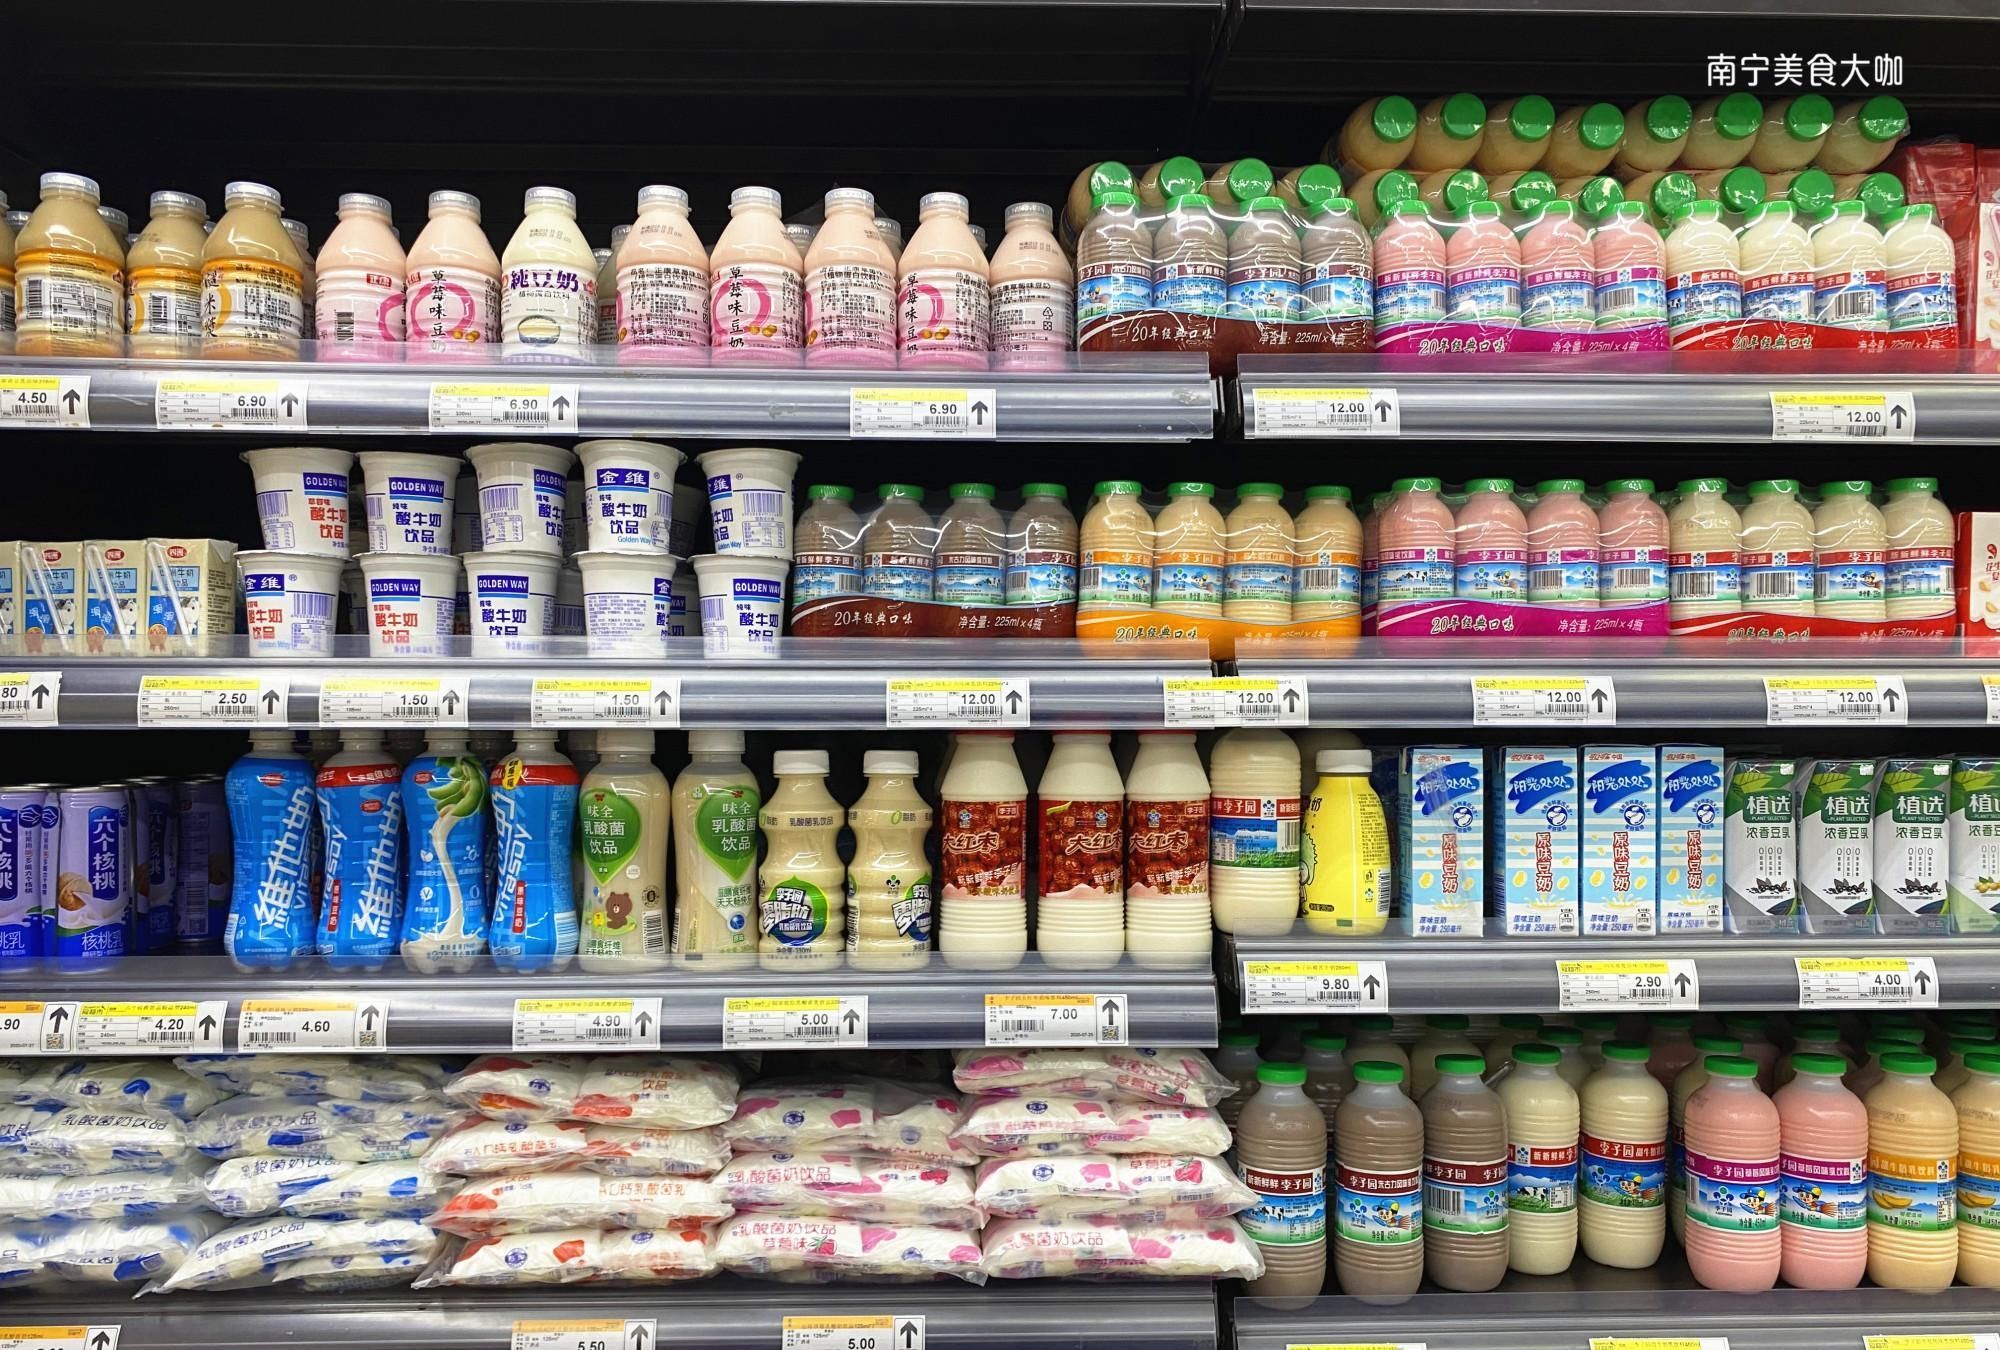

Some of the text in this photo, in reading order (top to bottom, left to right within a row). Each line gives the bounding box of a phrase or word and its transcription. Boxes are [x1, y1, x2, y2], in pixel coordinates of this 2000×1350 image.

[728, 266, 745, 348] 草莓味豆奶
[904, 273, 920, 355] 草莓味豆奶
[1130, 325, 1214, 342] 20年经典口味
[1418, 338, 1506, 357] 20年经典口味
[18, 392, 48, 404] 4.50
[237, 395, 267, 408] 6.90
[508, 398, 539, 411] 6.90
[928, 402, 958, 415] 6.90
[1329, 402, 1365, 413] 12.00
[1847, 411, 1882, 423] 12.00
[305, 476, 338, 487] GOLDEN
[599, 470, 647, 486] 金维
[391, 481, 444, 495] GOLDEN WAY
[310, 506, 347, 522] 酸牛奶
[601, 502, 647, 519] 酸牛奶
[395, 511, 442, 528] 酸牛奶
[319, 524, 344, 539] 饮品
[609, 520, 639, 535] 饮品
[404, 528, 435, 544] 饮品
[617, 535, 651, 546] Golden Way
[1477, 550, 1516, 561] 李子园
[1848, 550, 1883, 564] 李子园
[371, 582, 419, 592] GOLDEN WAY
[478, 579, 527, 590] GOLDEN WAY
[657, 581, 670, 594] 金
[735, 582, 762, 593] GOLDEN
[374, 612, 418, 627] 酸牛奶
[481, 608, 527, 623] 酸牛奶
[739, 612, 779, 628] 酸牛奶
[834, 611, 913, 626] 20年经典口味
[958, 615, 990, 629] 净含量：
[1431, 616, 1514, 634] 20年经典口味
[1557, 618, 1591, 633] 净含量：
[381, 629, 410, 644] 饮品
[748, 629, 774, 643] 饮品
[1114, 625, 1198, 642] 20年经典口味
[218, 693, 247, 704] 2.50
[400, 694, 428, 706] 1.50
[611, 694, 640, 706] 1.50
[960, 693, 996, 705] 12.00
[1238, 693, 1274, 704] 12.00
[1546, 692, 1582, 704] 12.00
[1838, 692, 1874, 704] 12.00
[1513, 776, 1566, 795] 阳光处处
[1591, 776, 1645, 794] 阳光处处
[1668, 775, 1715, 792] 阳光处处
[587, 804, 614, 818] 味全
[722, 801, 751, 815] 味全
[1223, 798, 1256, 814] 李子园
[1745, 795, 1791, 815] 植选
[1824, 795, 1871, 816] 植选
[1896, 795, 1944, 816] 植选
[583, 820, 625, 837] 乳酸菌
[711, 817, 757, 834] 乳酸菌
[1746, 826, 1791, 839] 浓香豆乳
[1895, 826, 1944, 839] 浓香豆乳
[1824, 827, 1869, 840] 浓香豆乳
[589, 840, 618, 855] 饮品
[720, 836, 751, 853] 饮品
[943, 831, 1000, 854] 大红枣
[1129, 830, 1189, 853] 大红枣
[93, 816, 116, 890] 六个核桃
[1686, 830, 1702, 890] 原味豆奶
[1442, 833, 1458, 894] 原味豆奶
[1535, 831, 1553, 892] 原味豆奶
[1613, 831, 1630, 892] 原味豆奶
[81, 930, 123, 950] 核桃乳
[1322, 979, 1350, 990] 9.80
[1635, 976, 1662, 988] 2.90
[1874, 974, 1901, 986] 4.00
[592, 1015, 621, 1027] 4.90
[801, 1014, 829, 1026] 5.00
[1050, 1008, 1078, 1021] 7.00
[155, 1018, 184, 1031] 4.20
[301, 1020, 331, 1033] 4.60
[61, 1114, 169, 1131] 乳酸菌奶饮品
[1600, 1142, 1634, 1158] 李子园
[1434, 1167, 1467, 1180] 李子园
[1712, 1166, 1745, 1178] 李子园
[1247, 1174, 1312, 1191] 新新鲜鲜 李子园
[1350, 1176, 1378, 1190] 李子园
[763, 1238, 808, 1251] 草莓味
[847, 1338, 875, 1350] 5.00
